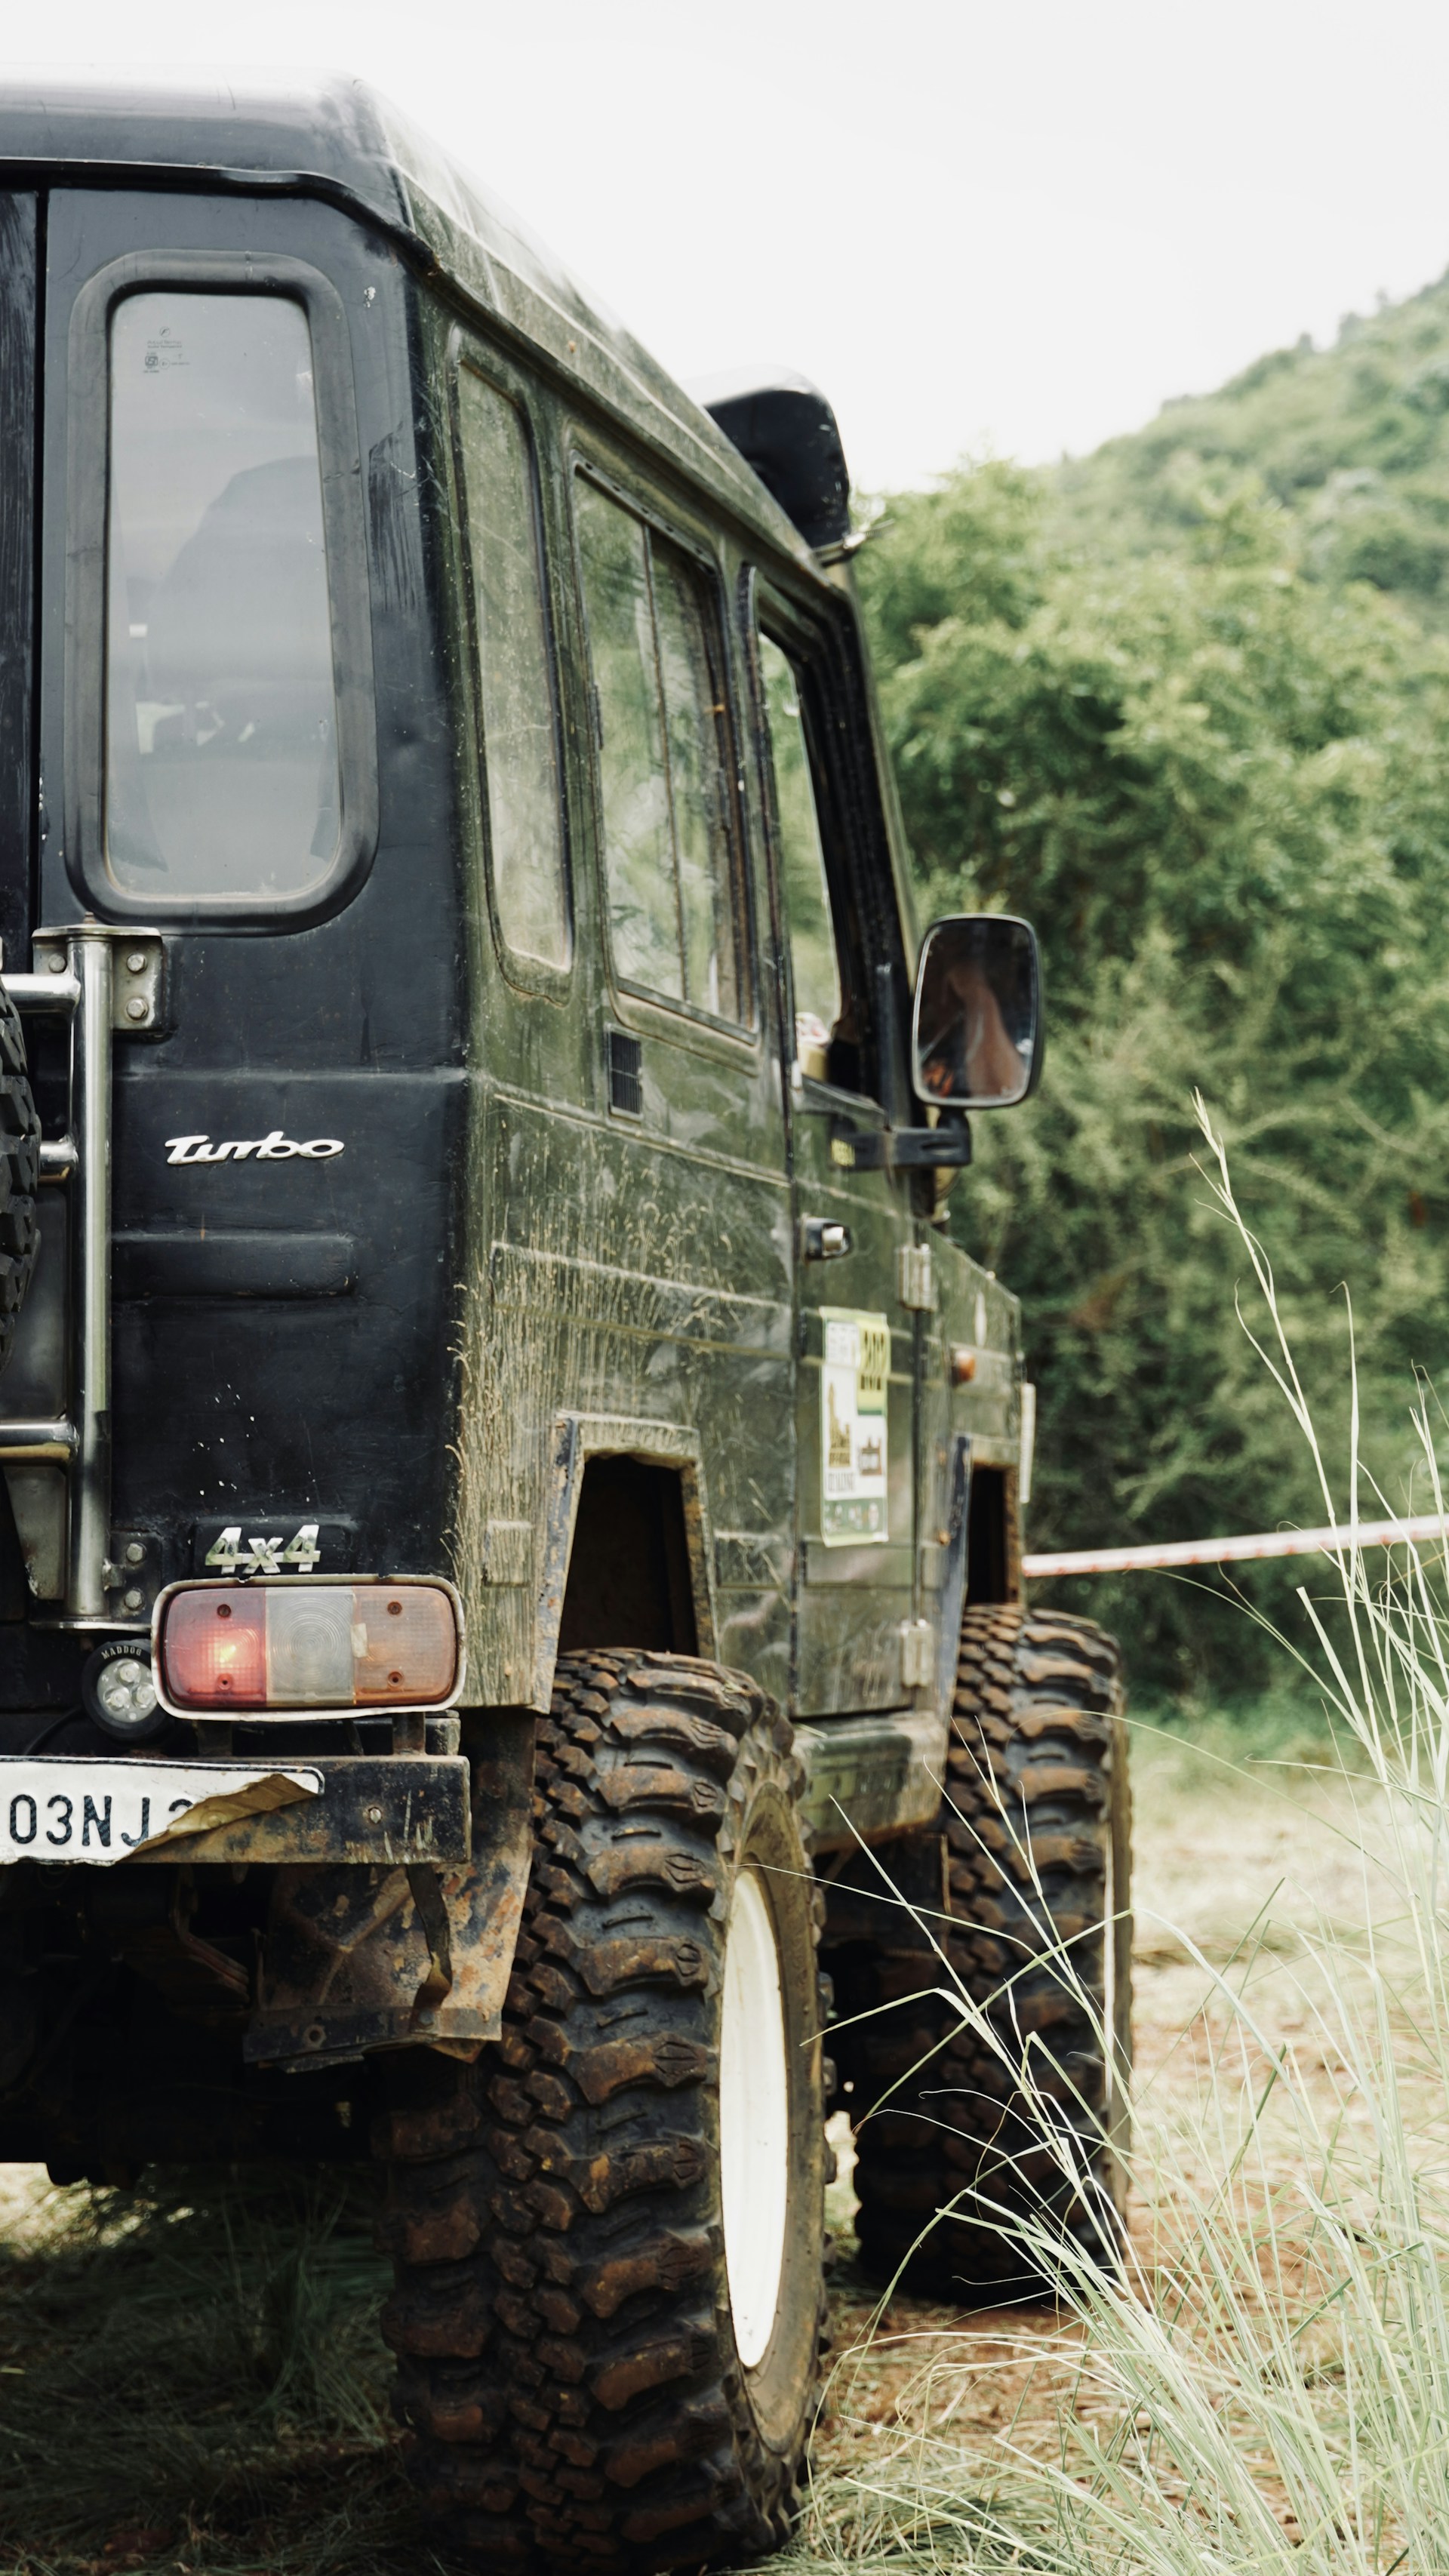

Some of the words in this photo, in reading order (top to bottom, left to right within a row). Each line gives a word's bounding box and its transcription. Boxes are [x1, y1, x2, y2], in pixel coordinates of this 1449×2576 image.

[165, 1131, 345, 1165] Turbo
[205, 1524, 321, 1574] 4x4
[100, 1645, 143, 1660] MADDOG
[9, 1793, 195, 1848] 03NJ
